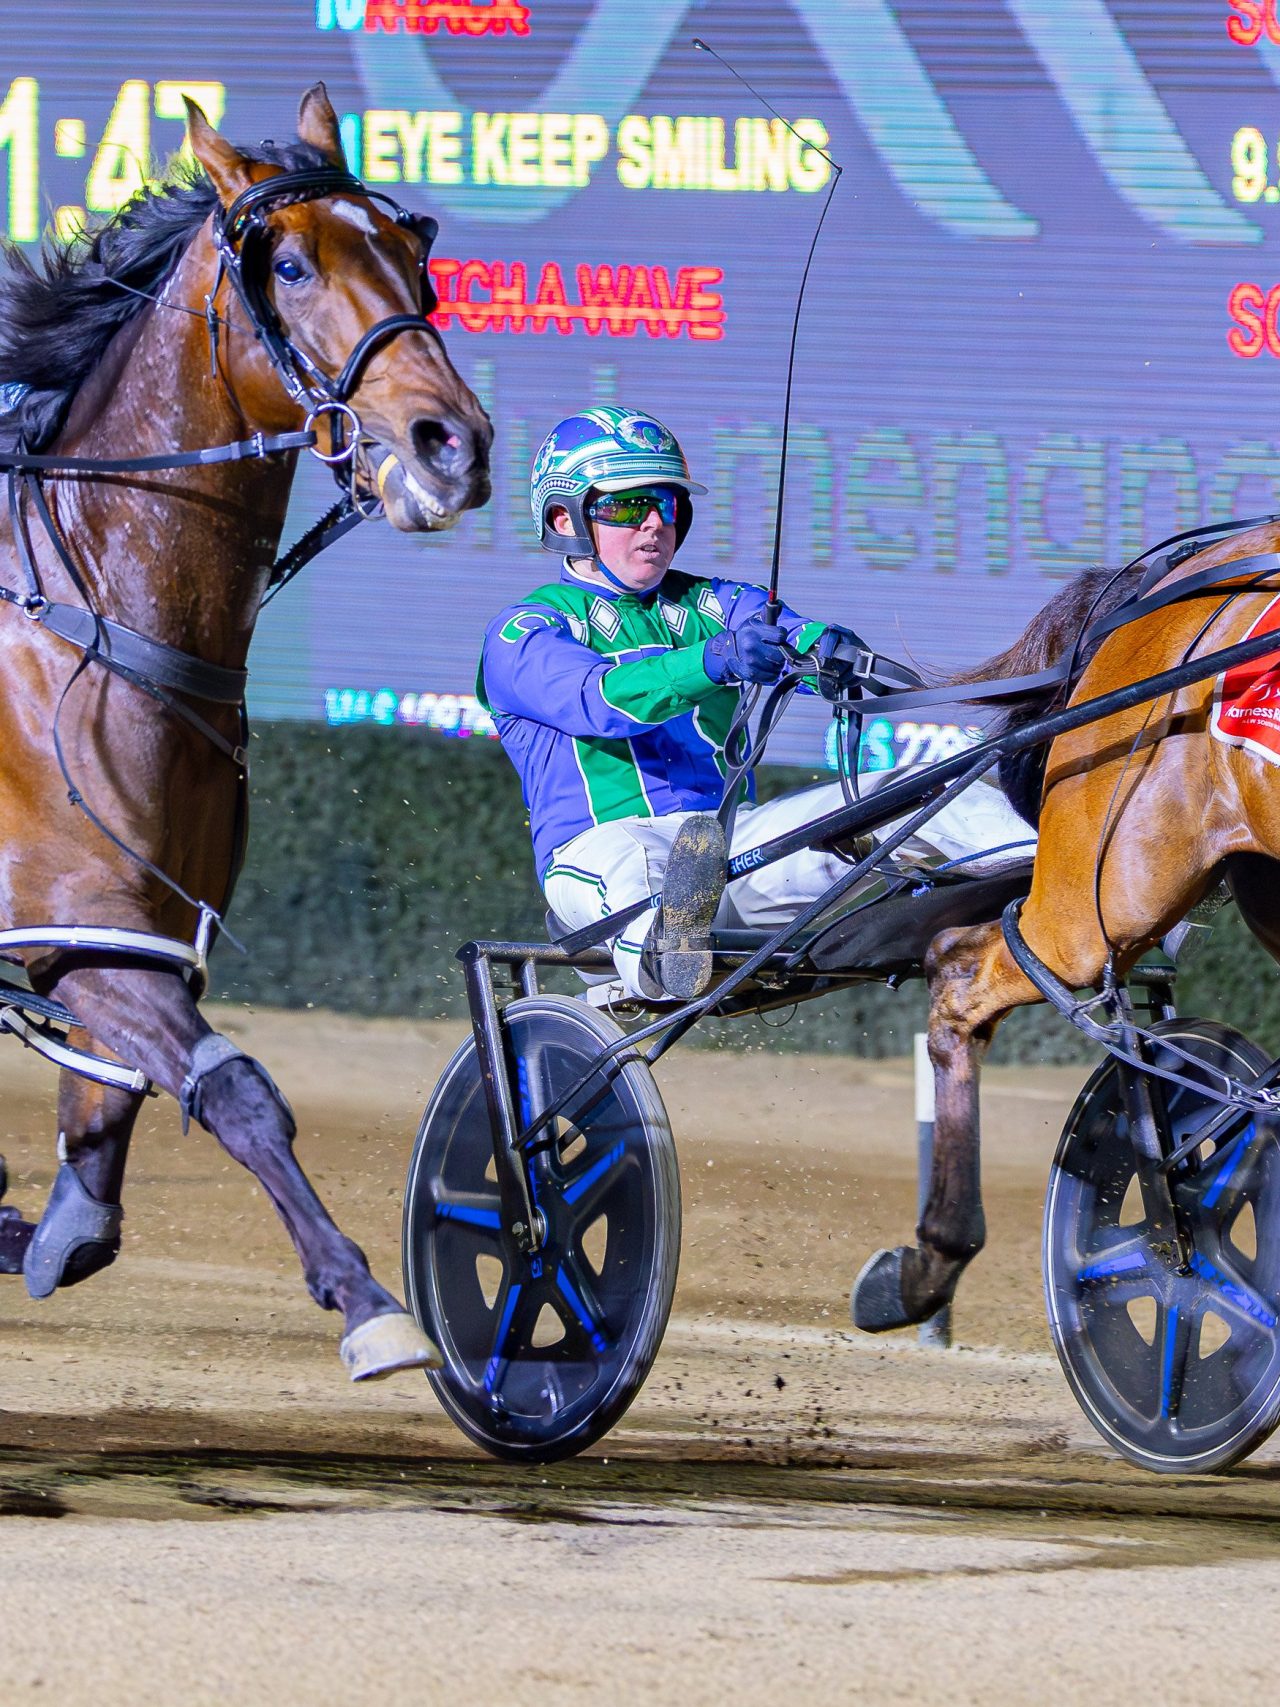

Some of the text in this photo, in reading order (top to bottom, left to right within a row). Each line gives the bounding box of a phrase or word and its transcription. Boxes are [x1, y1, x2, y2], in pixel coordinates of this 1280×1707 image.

[363, 110, 464, 184] EYE
[471, 112, 609, 187] KEEP
[616, 114, 832, 192] SMILING
[428, 258, 527, 334] TCH
[534, 262, 575, 335] A
[576, 264, 724, 339] WAVE
